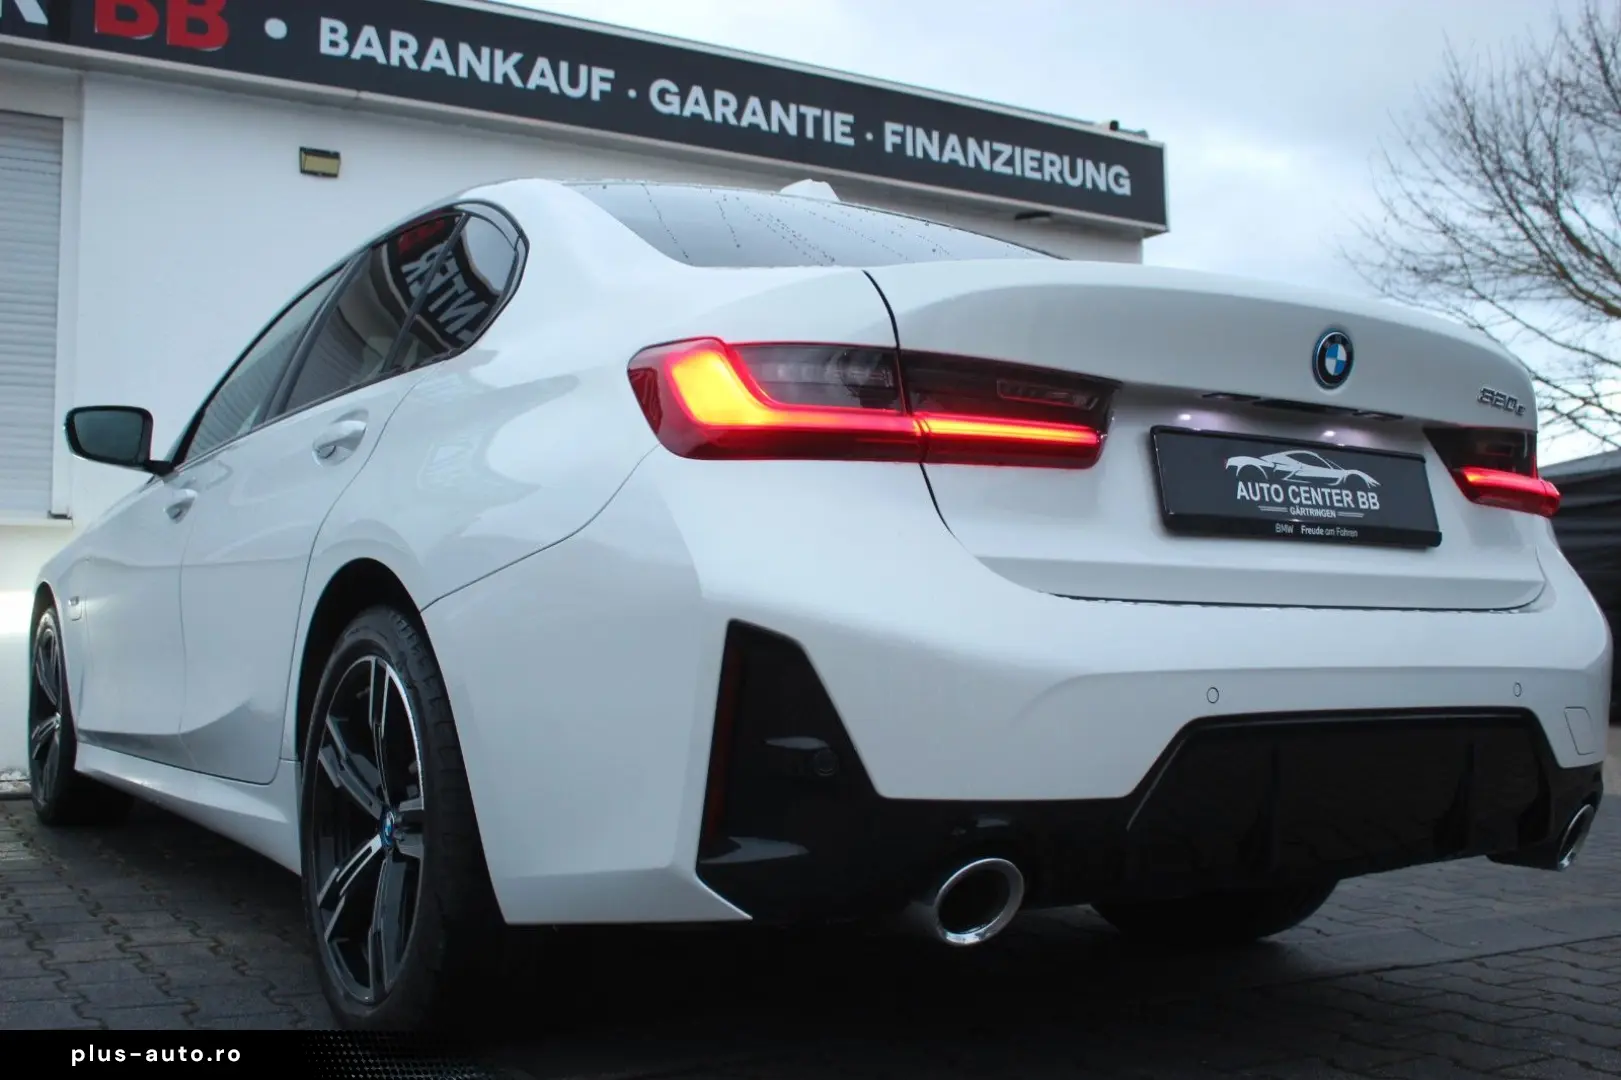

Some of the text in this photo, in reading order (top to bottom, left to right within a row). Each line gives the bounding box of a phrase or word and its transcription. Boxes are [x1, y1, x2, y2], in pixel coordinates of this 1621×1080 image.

[319, 17, 616, 101] BARANKAUF
[649, 78, 856, 147] GARANTIE
[884, 121, 1132, 197] FINANZIERUNG
[1236, 481, 1380, 510] AUTO CENTER BB
[1289, 505, 1337, 518] GÄRTRINGEN
[1275, 523, 1294, 534] BMW
[1301, 525, 1324, 536] Freude
[1336, 527, 1358, 537] Fahren
